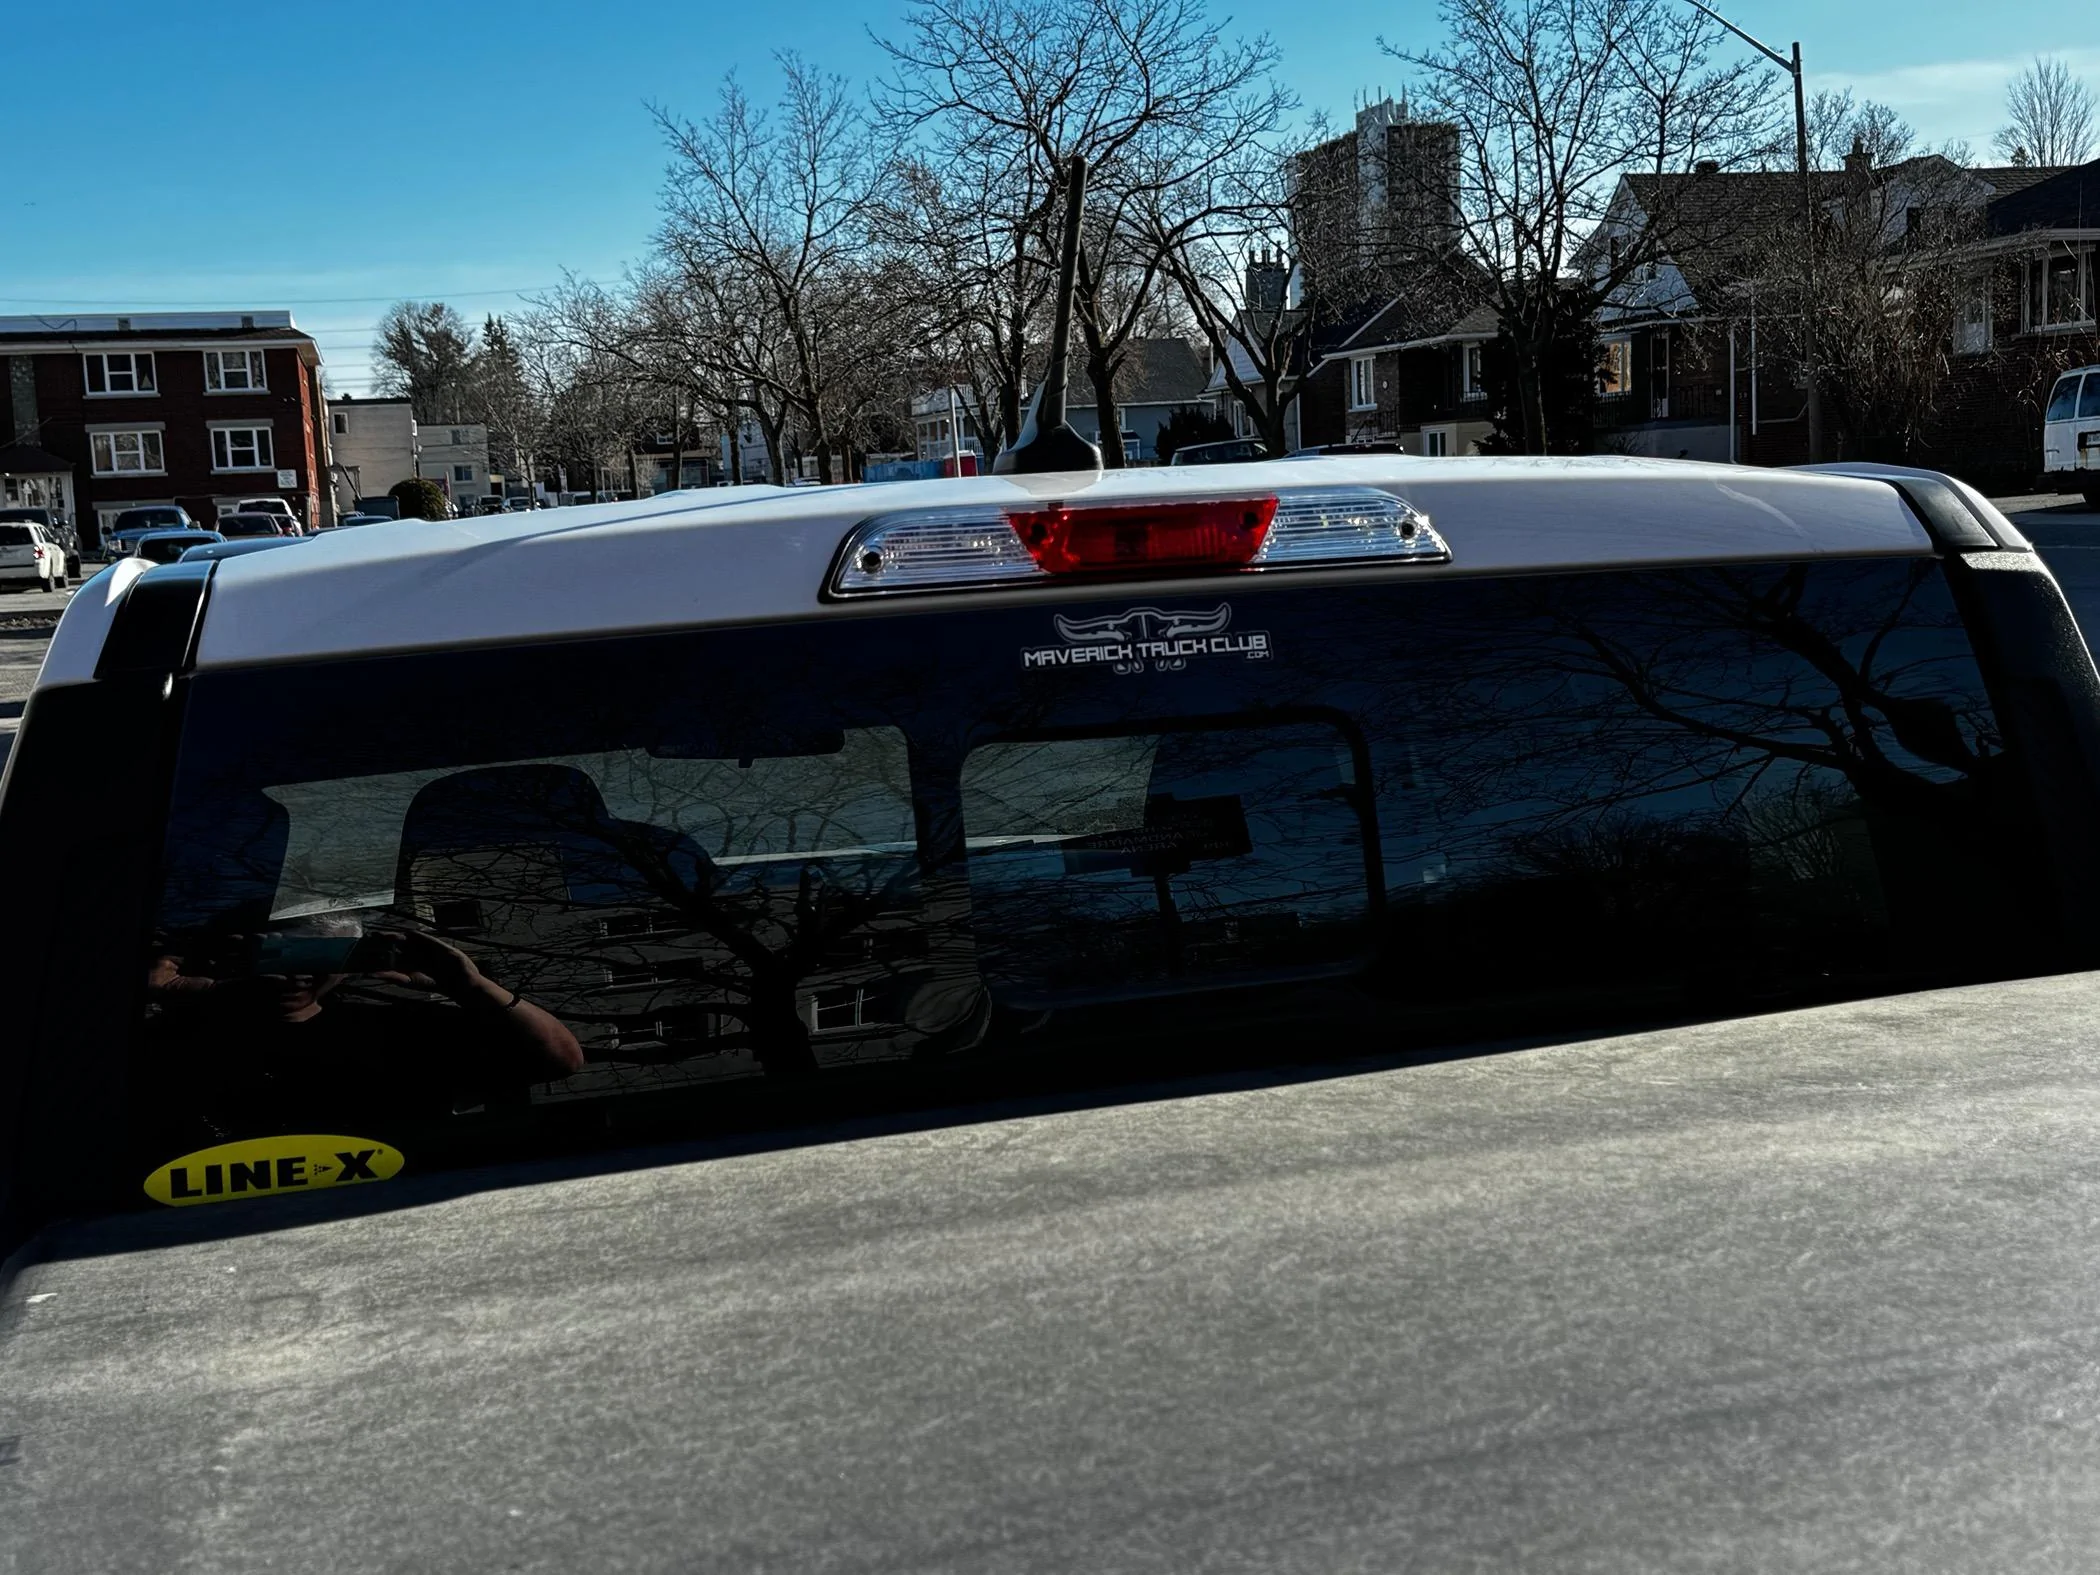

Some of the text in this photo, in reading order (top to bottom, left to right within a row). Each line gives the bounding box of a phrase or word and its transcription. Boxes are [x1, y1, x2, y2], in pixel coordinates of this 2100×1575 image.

[1024, 634, 1268, 667] MAVERICK TRUCK CLUB
